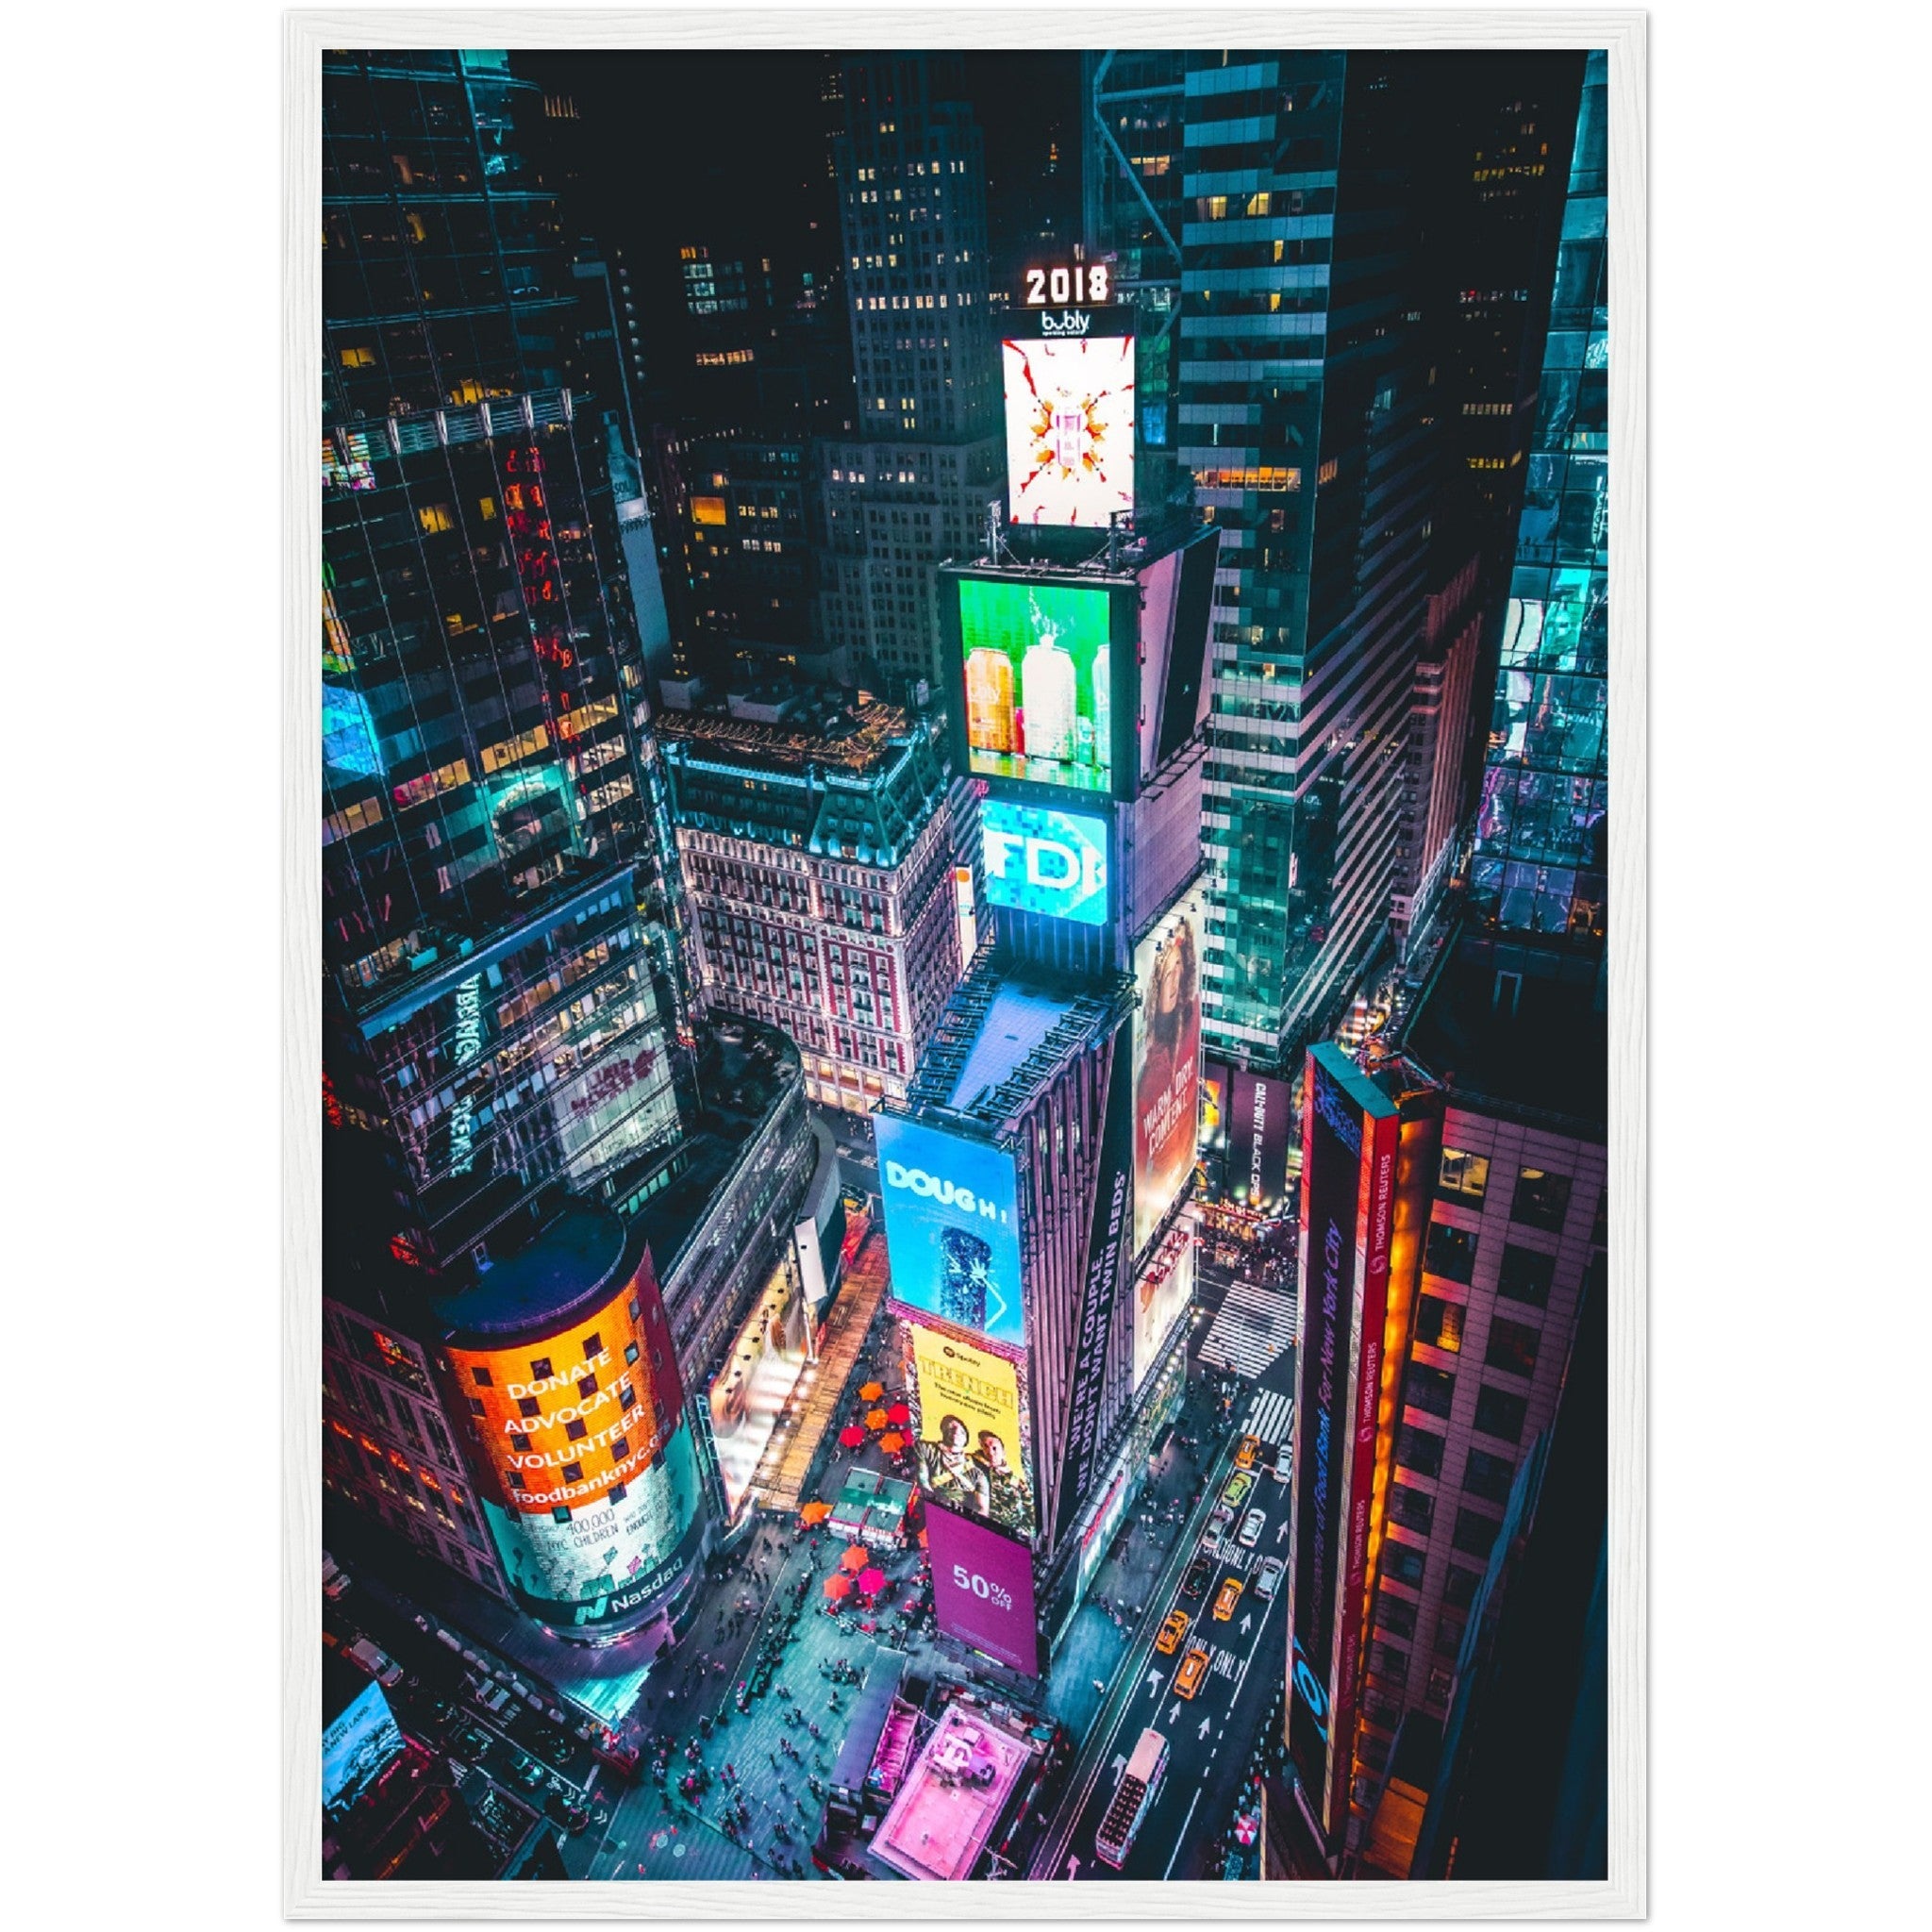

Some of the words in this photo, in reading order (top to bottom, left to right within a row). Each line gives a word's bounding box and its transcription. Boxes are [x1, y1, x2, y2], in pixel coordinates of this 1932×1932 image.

[1026, 265, 1108, 304] 2018
[1251, 1133, 1263, 1170] BLACK
[1250, 1173, 1260, 1197] OPS
[1379, 1154, 1391, 1204] REUTERS
[1324, 1217, 1343, 1270] City
[1374, 1204, 1387, 1251] THOMSON
[1100, 1241, 1118, 1306] TWIN
[1323, 1269, 1338, 1321] York
[1082, 1248, 1104, 1350] COUPLE.
[1079, 1352, 1091, 1369] A
[1091, 1312, 1108, 1384] WANT
[1321, 1320, 1335, 1375] New
[1367, 1341, 1377, 1380] REUTERS
[507, 1346, 611, 1400] DONATE
[919, 1356, 1014, 1410] TRENCH
[1318, 1371, 1333, 1411] For
[505, 1371, 632, 1434] ADVOCATE
[1080, 1386, 1099, 1457] DON'T
[1362, 1380, 1374, 1424] THOMSON
[507, 1404, 645, 1469] VOLUNTEER
[1315, 1407, 1331, 1463] Bank
[1076, 1457, 1089, 1498] WE
[1313, 1457, 1328, 1506] Food
[574, 1523, 619, 1548] CHILDREN
[1224, 1543, 1255, 1573] ONLY
[611, 1556, 684, 1613] Nasdaq
[954, 1564, 1012, 1605] 50%
[991, 1596, 1013, 1611] OFF
[1213, 1649, 1246, 1683] ONLY
